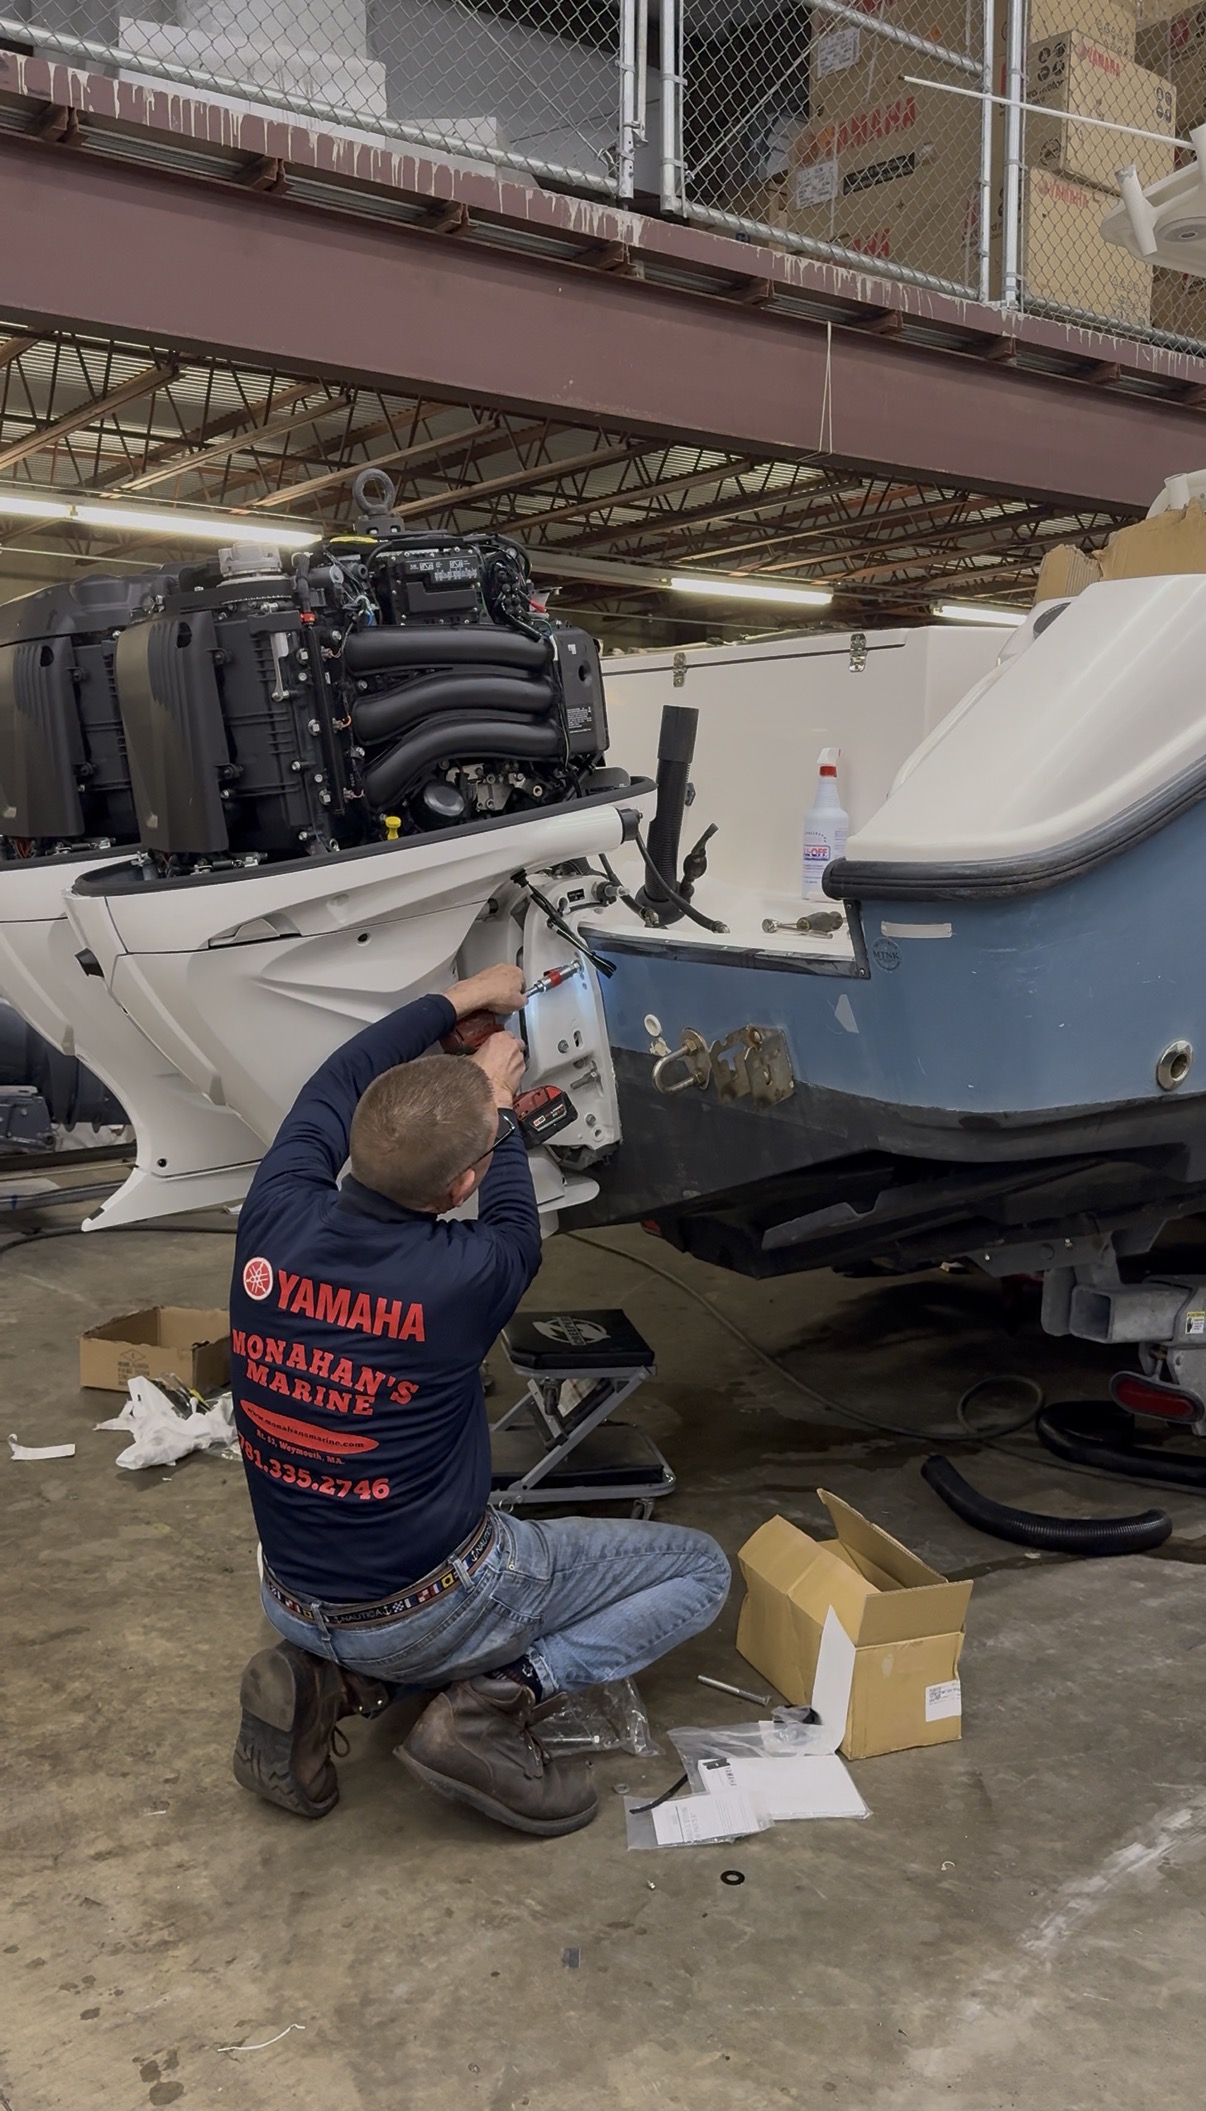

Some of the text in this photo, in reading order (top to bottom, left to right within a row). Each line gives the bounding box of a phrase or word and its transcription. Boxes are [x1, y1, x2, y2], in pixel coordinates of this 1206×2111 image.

[277, 1269, 426, 1343] YAMAHA
[232, 1328, 420, 1405] MONAHAN'S
[246, 1359, 376, 1416] MARINE
[246, 1408, 365, 1448] www.monahansmarine.com
[279, 1440, 325, 1462] Weymouth,
[238, 1431, 391, 1500] 781.335.2746
[341, 1609, 383, 1622] NAUTICA
